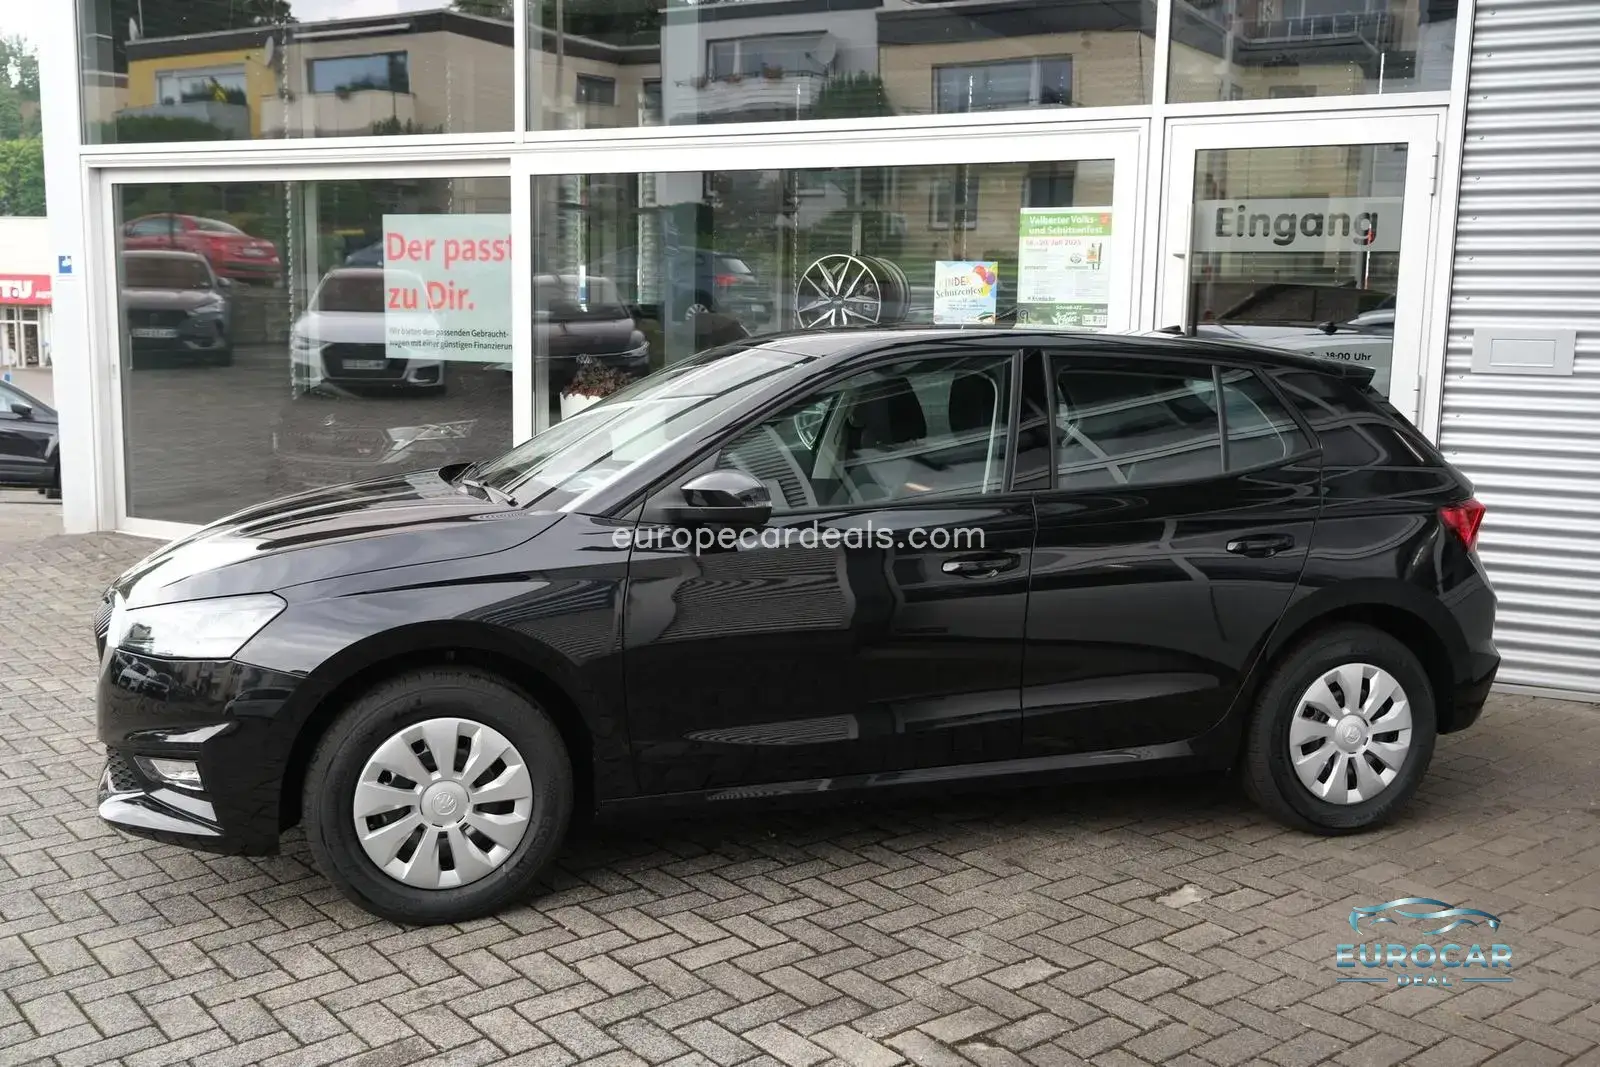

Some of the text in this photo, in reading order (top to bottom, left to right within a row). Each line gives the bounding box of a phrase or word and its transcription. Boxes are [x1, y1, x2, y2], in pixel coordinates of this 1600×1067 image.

[1071, 215, 1097, 224] Volks-
[1029, 226, 1046, 235] und
[1215, 205, 1378, 246] Eingang
[386, 232, 436, 262] Der
[388, 280, 475, 311] zu Dir.
[436, 328, 471, 339] passenden
[471, 329, 509, 338] Gebraucht-
[410, 339, 422, 347] mit
[422, 339, 440, 348] einer
[440, 340, 473, 351] günstigen
[1354, 351, 1373, 361] Uhr
